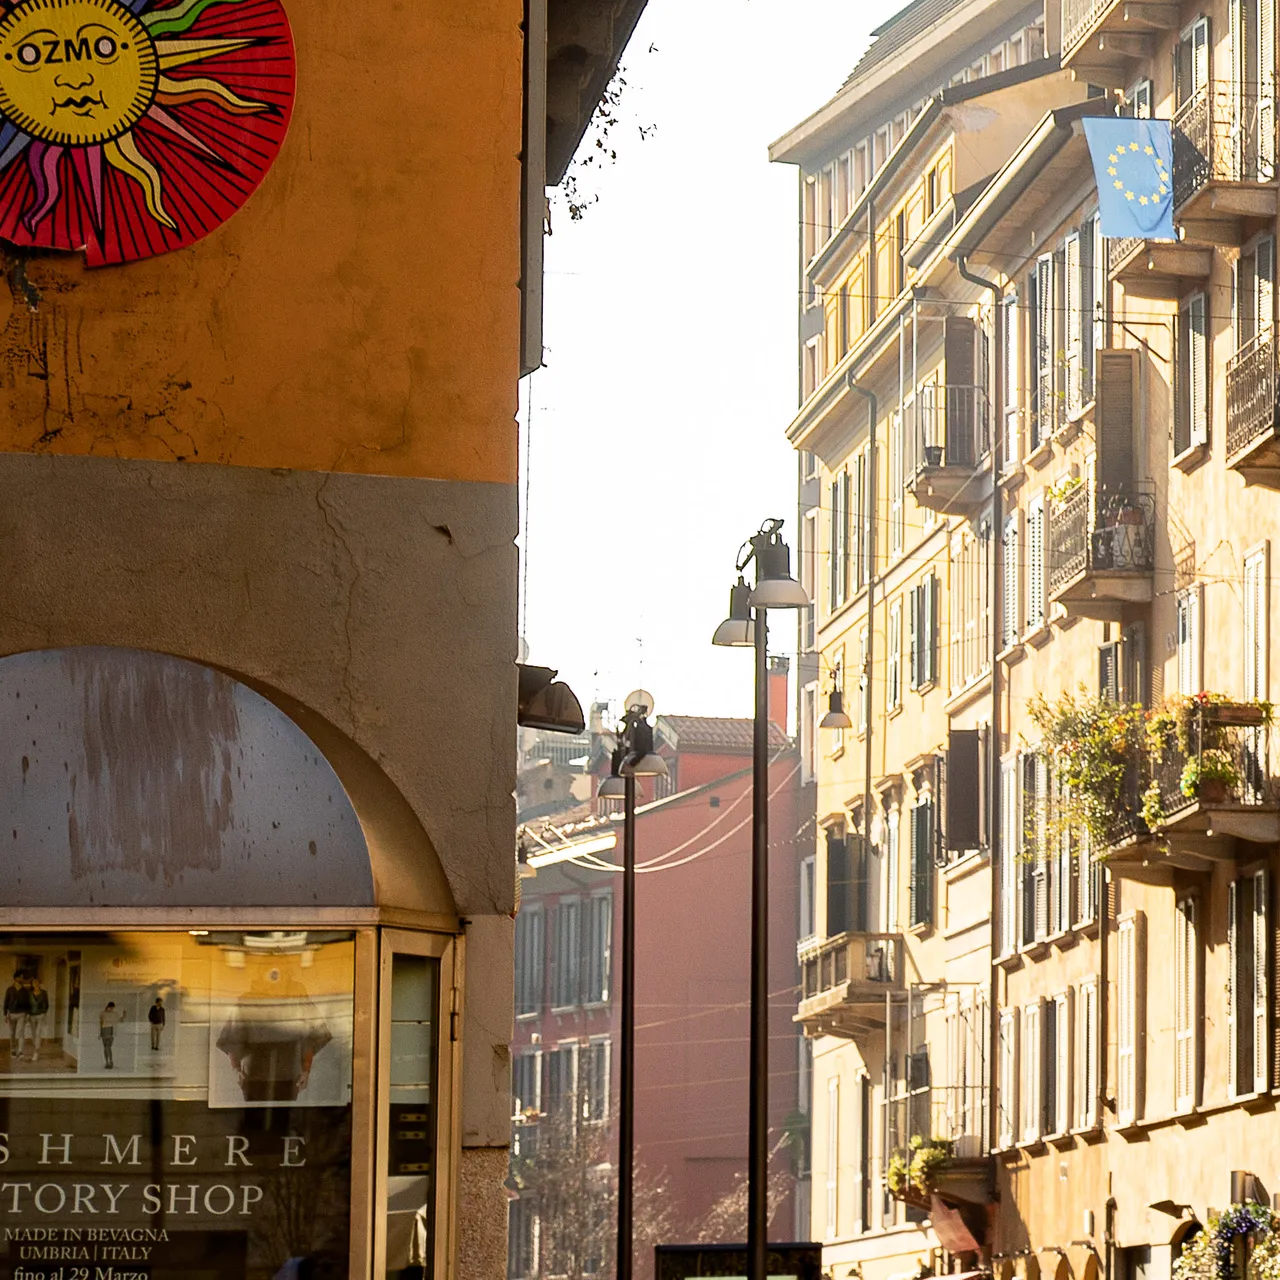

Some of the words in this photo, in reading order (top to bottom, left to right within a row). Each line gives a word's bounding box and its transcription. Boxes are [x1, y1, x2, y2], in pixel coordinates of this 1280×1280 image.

[17, 36, 118, 66] OZMO
[141, 1183, 264, 1215] SHOP
[4, 1227, 58, 1242] MADE
[63, 1228, 82, 1242] IN
[87, 1228, 170, 1243] BEVAGNA
[19, 1246, 89, 1261] UMBRIA
[102, 1246, 153, 1261] ITALY
[14, 1267, 45, 1280] fino
[50, 1267, 64, 1280] al
[69, 1268, 89, 1280] 29
[95, 1267, 148, 1280] Marzo
